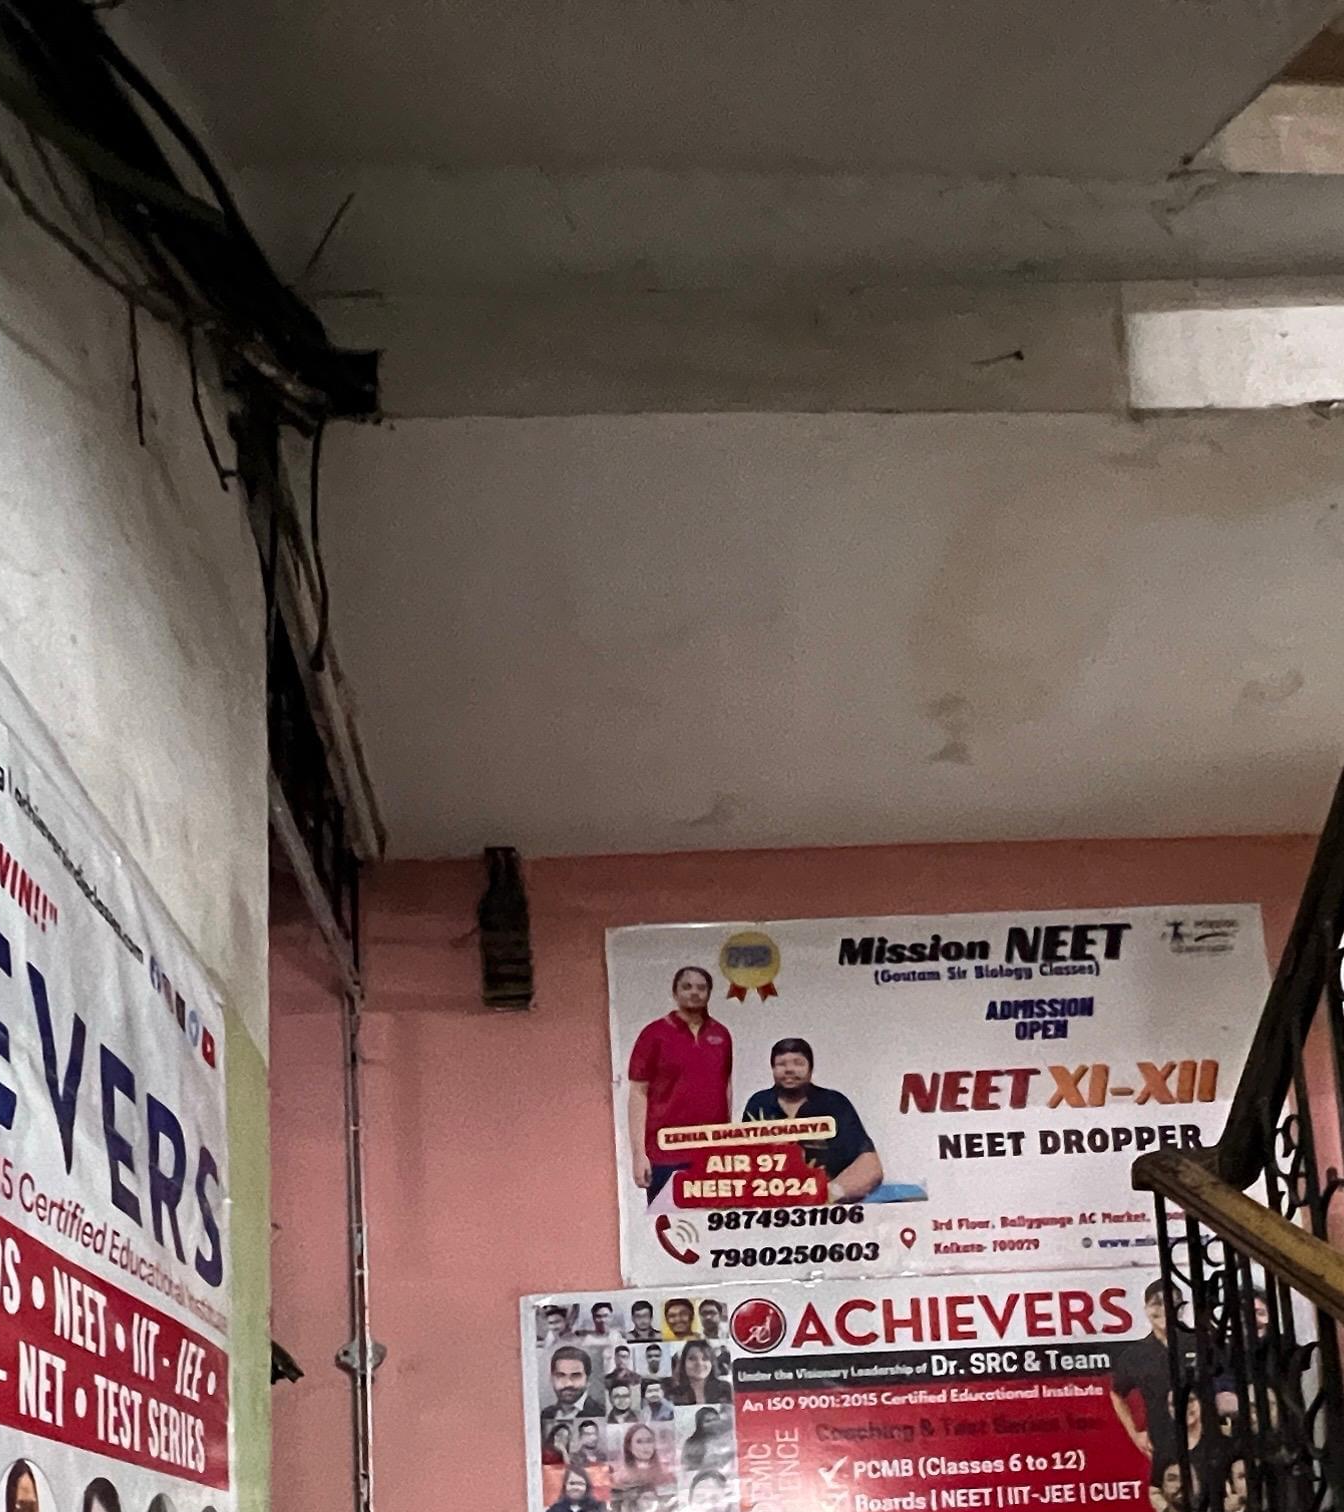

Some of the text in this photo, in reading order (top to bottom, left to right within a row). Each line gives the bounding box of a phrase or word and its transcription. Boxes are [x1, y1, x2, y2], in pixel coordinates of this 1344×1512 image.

[838, 922, 1132, 967] Mission NEET
[984, 996, 1095, 1021] ADMISSION
[1014, 1019, 1069, 1041] OPEN
[899, 1058, 1220, 1115] NEET XI-XII
[937, 1123, 1203, 1160] NEET DROPPER
[706, 1153, 788, 1174] AIR 97
[682, 1177, 819, 1199] NEET 2024
[18, 1172, 106, 1256] Certified
[707, 1204, 866, 1232] 9874931106
[1078, 1212, 1097, 1225] AC
[709, 1242, 881, 1269] 7980250603
[789, 1287, 1134, 1350] ACHIEVERS
[52, 1265, 108, 1358] NEET
[131, 1312, 161, 1382] IIT
[174, 1338, 207, 1403] JEE
[774, 1367, 794, 1381] the
[915, 1361, 928, 1375] of
[930, 1354, 965, 1377] Dr.
[969, 1352, 1019, 1376] SRC
[1023, 1353, 1041, 1372] &
[1048, 1349, 1111, 1371] Team
[18, 1340, 67, 1428] NET
[93, 1373, 143, 1453] TEST
[146, 1398, 207, 1474] SERIES
[742, 1383, 1105, 1413] An ISO 9001:2015 Certified Educational Institute
[853, 1449, 1087, 1479] PCMB (Classes 6 to 12)
[941, 1487, 993, 1509] NEET
[1007, 1484, 1077, 1506] IIT-JEE
[1089, 1480, 1143, 1501] CUET
